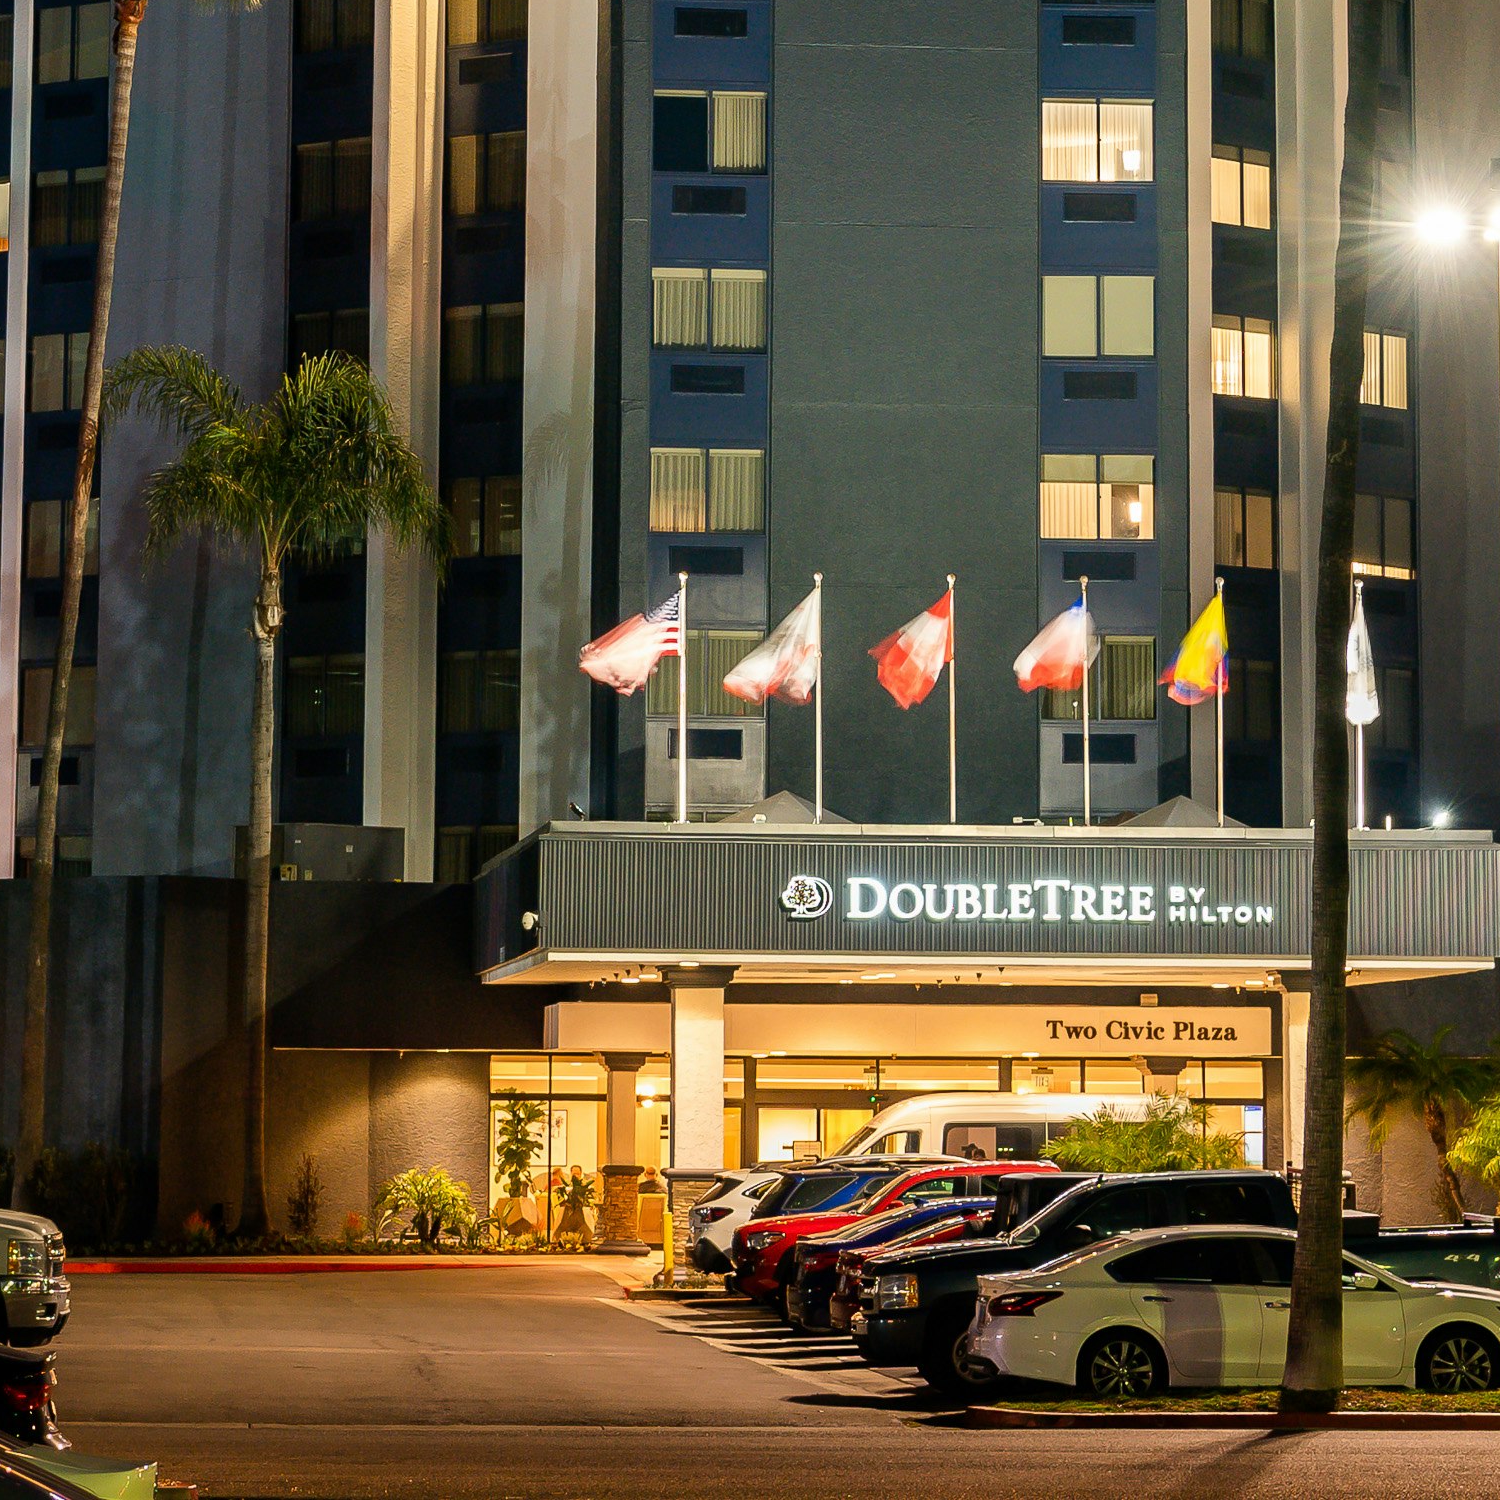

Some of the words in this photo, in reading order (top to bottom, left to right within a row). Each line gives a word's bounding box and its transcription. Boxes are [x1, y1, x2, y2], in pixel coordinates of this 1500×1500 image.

[1169, 886, 1206, 903] BY
[1169, 905, 1274, 923] HILTON
[1046, 1020, 1097, 1040] Two
[1105, 1020, 1165, 1040] Civic
[1173, 1021, 1238, 1041] Plaza
